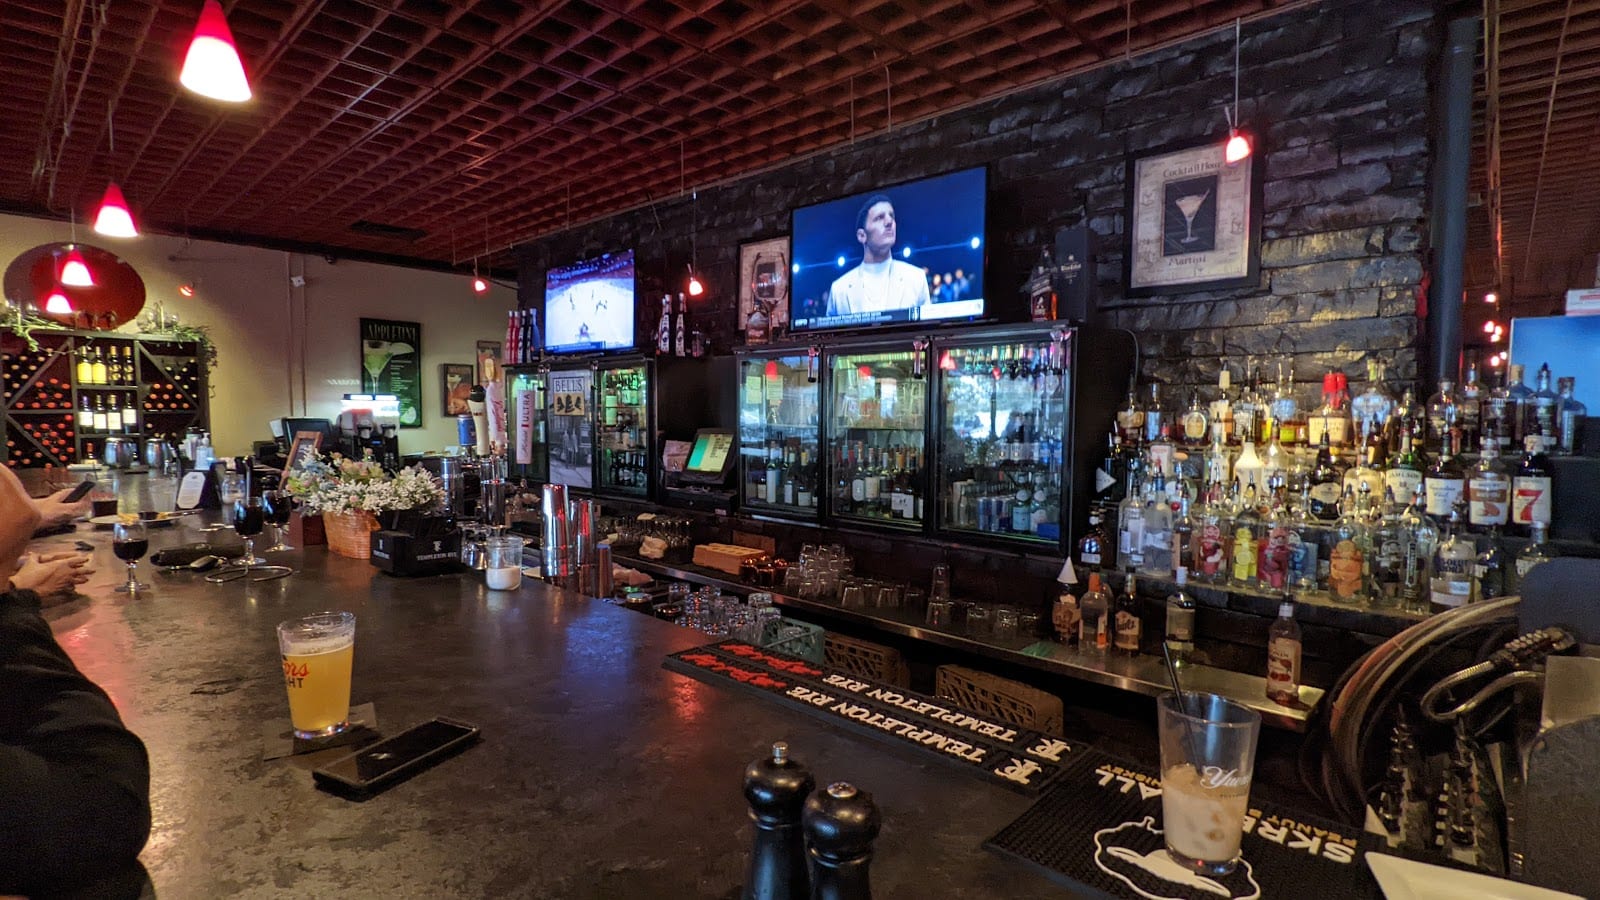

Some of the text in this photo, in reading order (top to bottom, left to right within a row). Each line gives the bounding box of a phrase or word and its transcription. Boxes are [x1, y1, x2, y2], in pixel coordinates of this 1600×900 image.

[522, 394, 530, 422] ULTRA
[1516, 489, 1544, 521] 7
[786, 686, 835, 706] RYE
[822, 674, 870, 692] RYE
[865, 688, 1017, 743] TEMPLETON
[830, 702, 986, 763] TEMPLETON
[1100, 764, 1357, 848] PEANUT HISKEY
